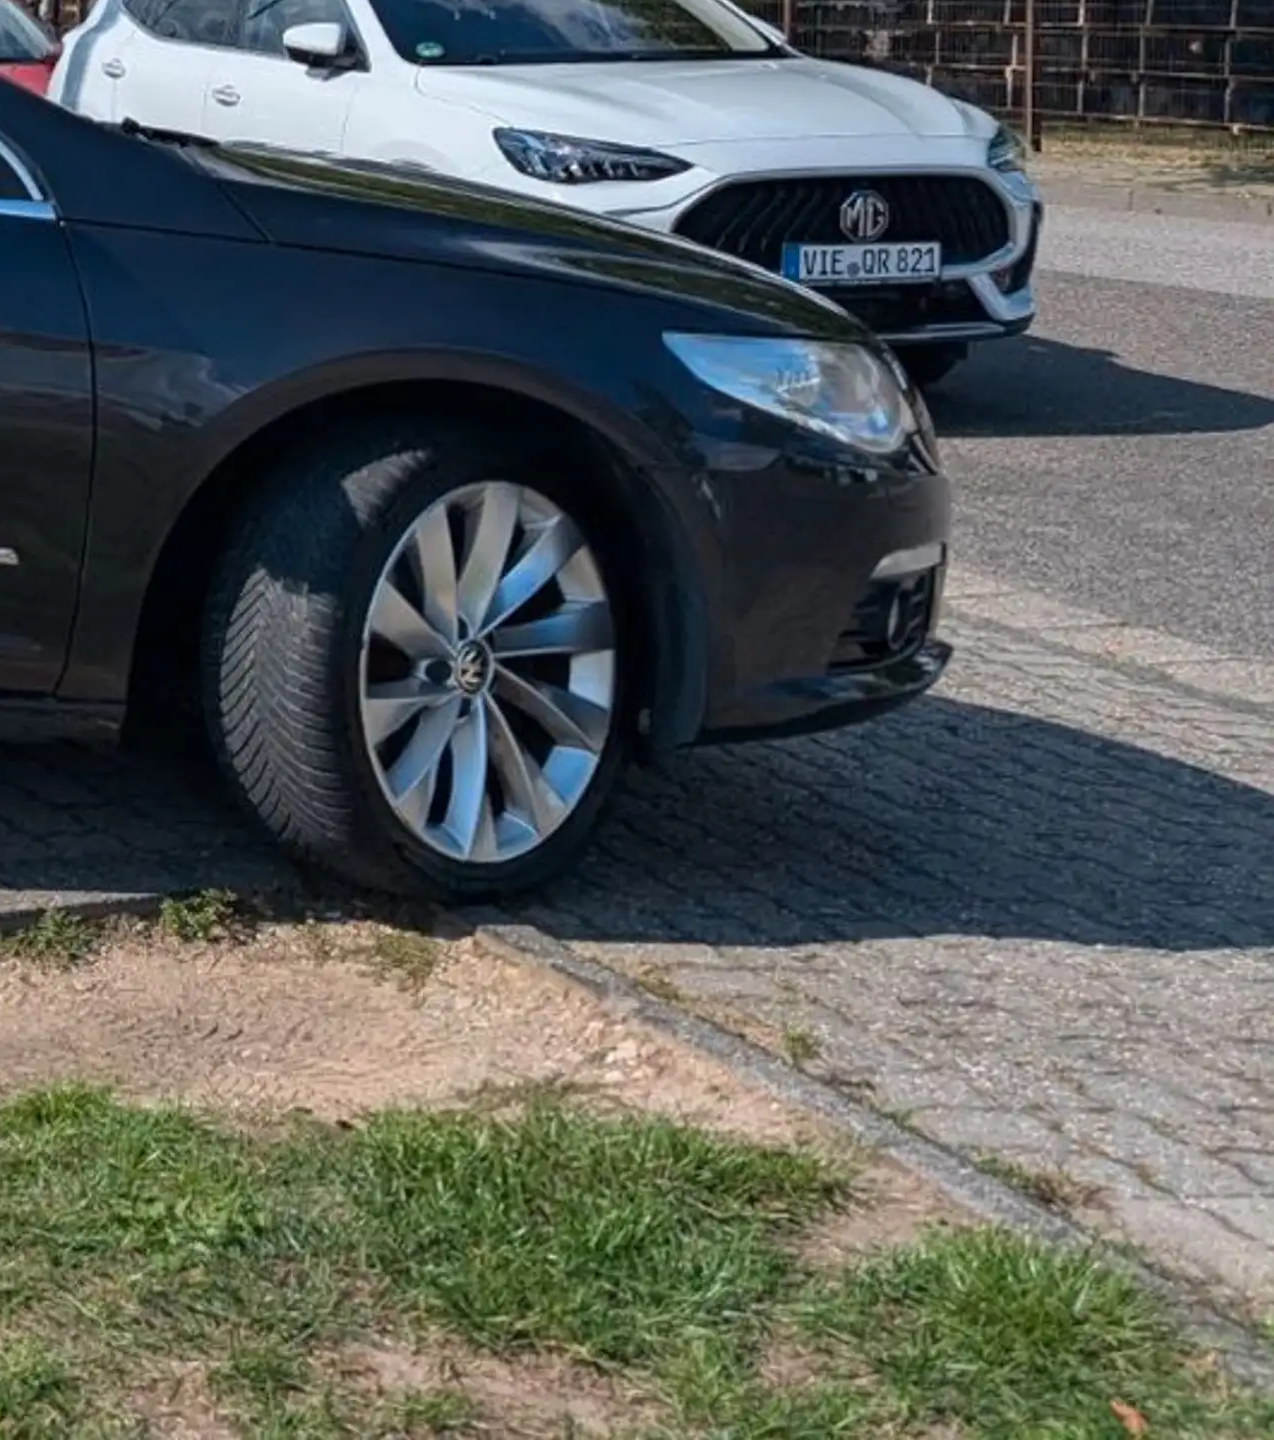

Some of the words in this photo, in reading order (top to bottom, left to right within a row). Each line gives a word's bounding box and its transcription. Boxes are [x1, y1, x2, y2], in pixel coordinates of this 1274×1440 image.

[841, 192, 888, 240] MG
[803, 249, 845, 275] VIE
[862, 248, 890, 274] QR
[897, 247, 935, 273] 821
